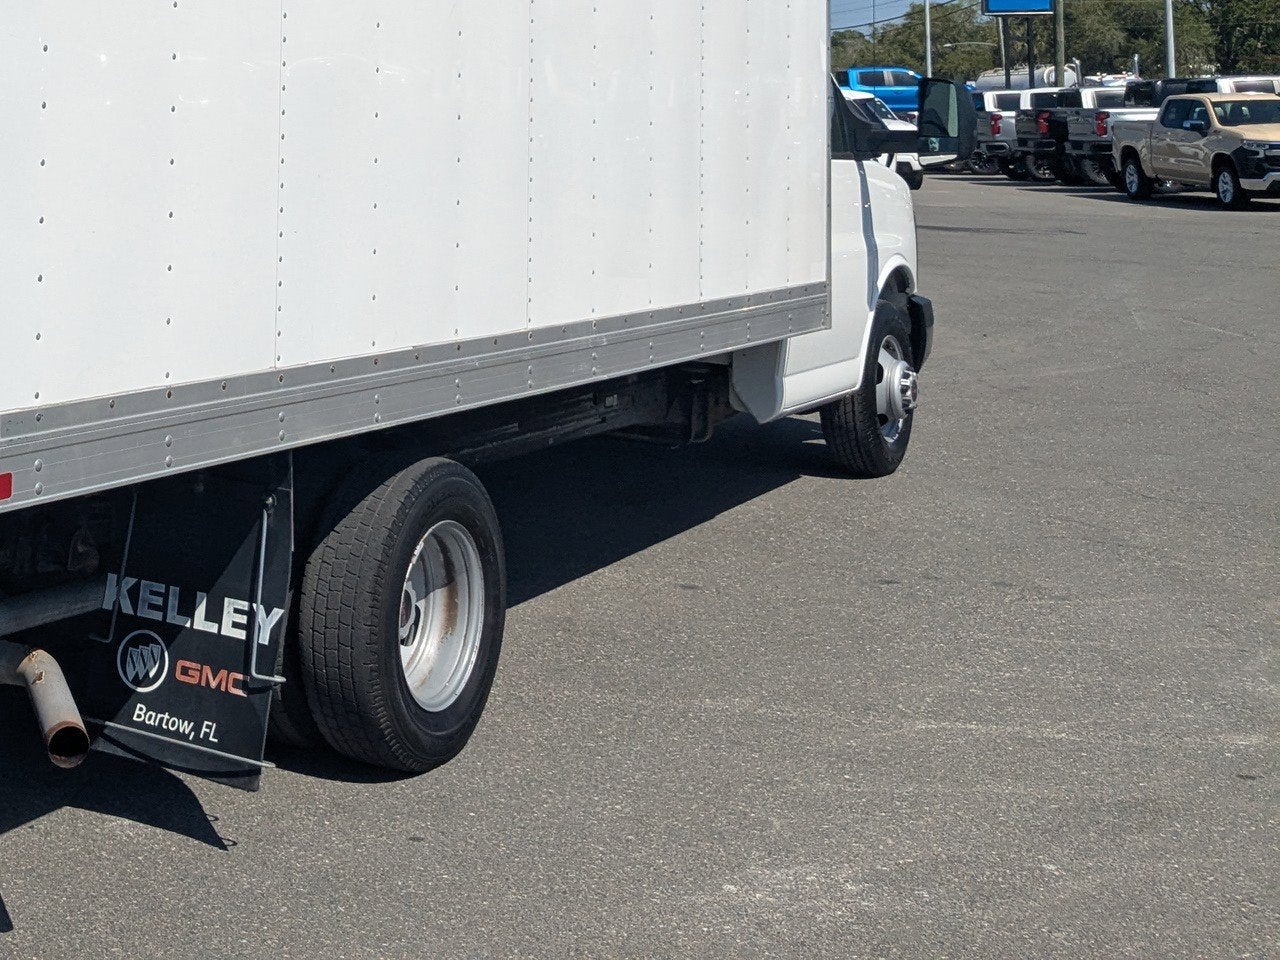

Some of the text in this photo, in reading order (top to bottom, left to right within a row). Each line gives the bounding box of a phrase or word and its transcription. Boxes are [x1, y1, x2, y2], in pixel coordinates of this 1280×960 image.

[101, 572, 285, 645] KELLEY
[175, 659, 248, 698] GMC
[133, 703, 219, 743] Bartow, FL
